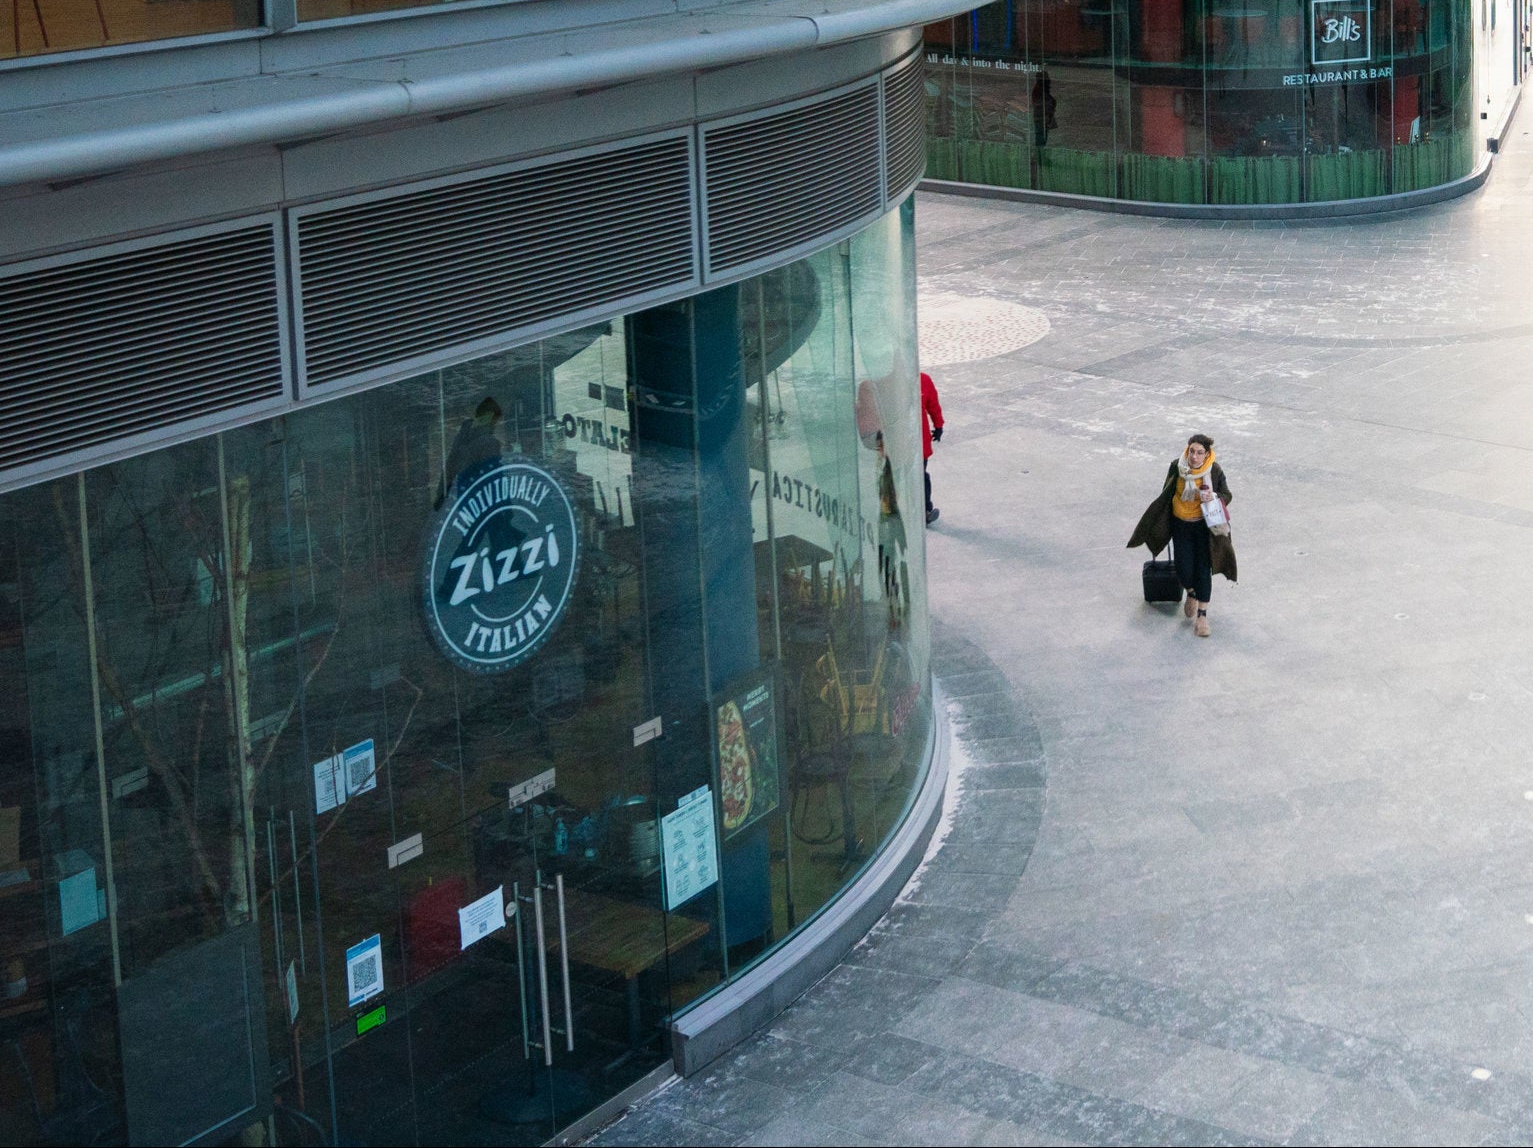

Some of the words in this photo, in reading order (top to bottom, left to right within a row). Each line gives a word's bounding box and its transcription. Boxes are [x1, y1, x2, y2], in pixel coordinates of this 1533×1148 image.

[1322, 15, 1361, 43] Bill's
[926, 53, 938, 64] All
[961, 57, 969, 66] &
[972, 56, 991, 68] into
[995, 59, 1010, 70] the
[1282, 69, 1359, 86] RESTAURANT
[1360, 69, 1368, 79] &
[1369, 67, 1392, 79] BAR
[452, 475, 550, 536] INDIVIDUALLY
[449, 523, 560, 606] Zizzi
[463, 593, 552, 652] ITALIAN
